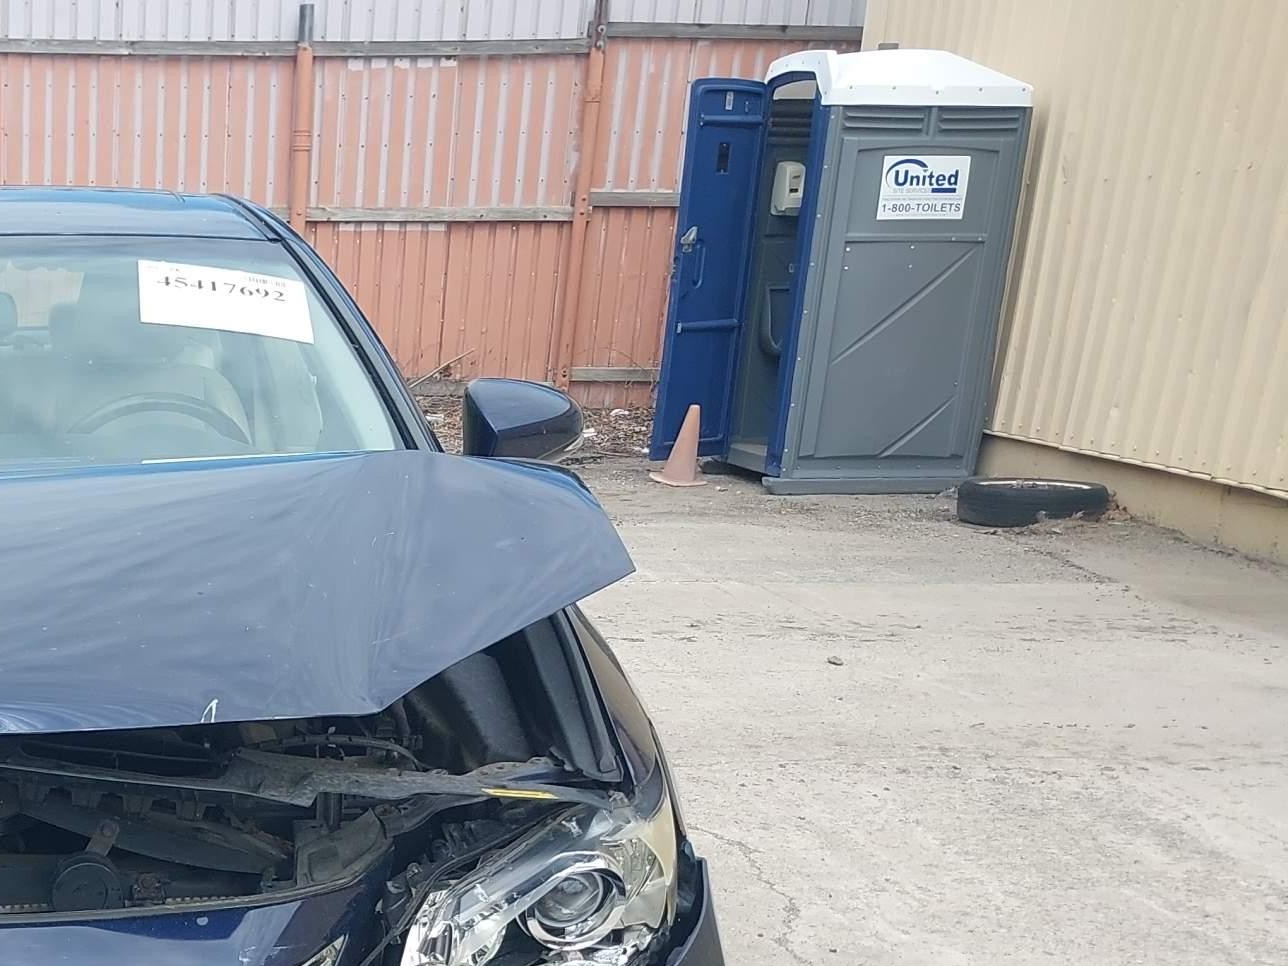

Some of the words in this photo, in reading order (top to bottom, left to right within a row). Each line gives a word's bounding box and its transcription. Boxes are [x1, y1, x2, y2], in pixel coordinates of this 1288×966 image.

[894, 169, 959, 187] United
[881, 203, 961, 213] 1-800-TOILETS
[157, 276, 286, 302] 45417692
